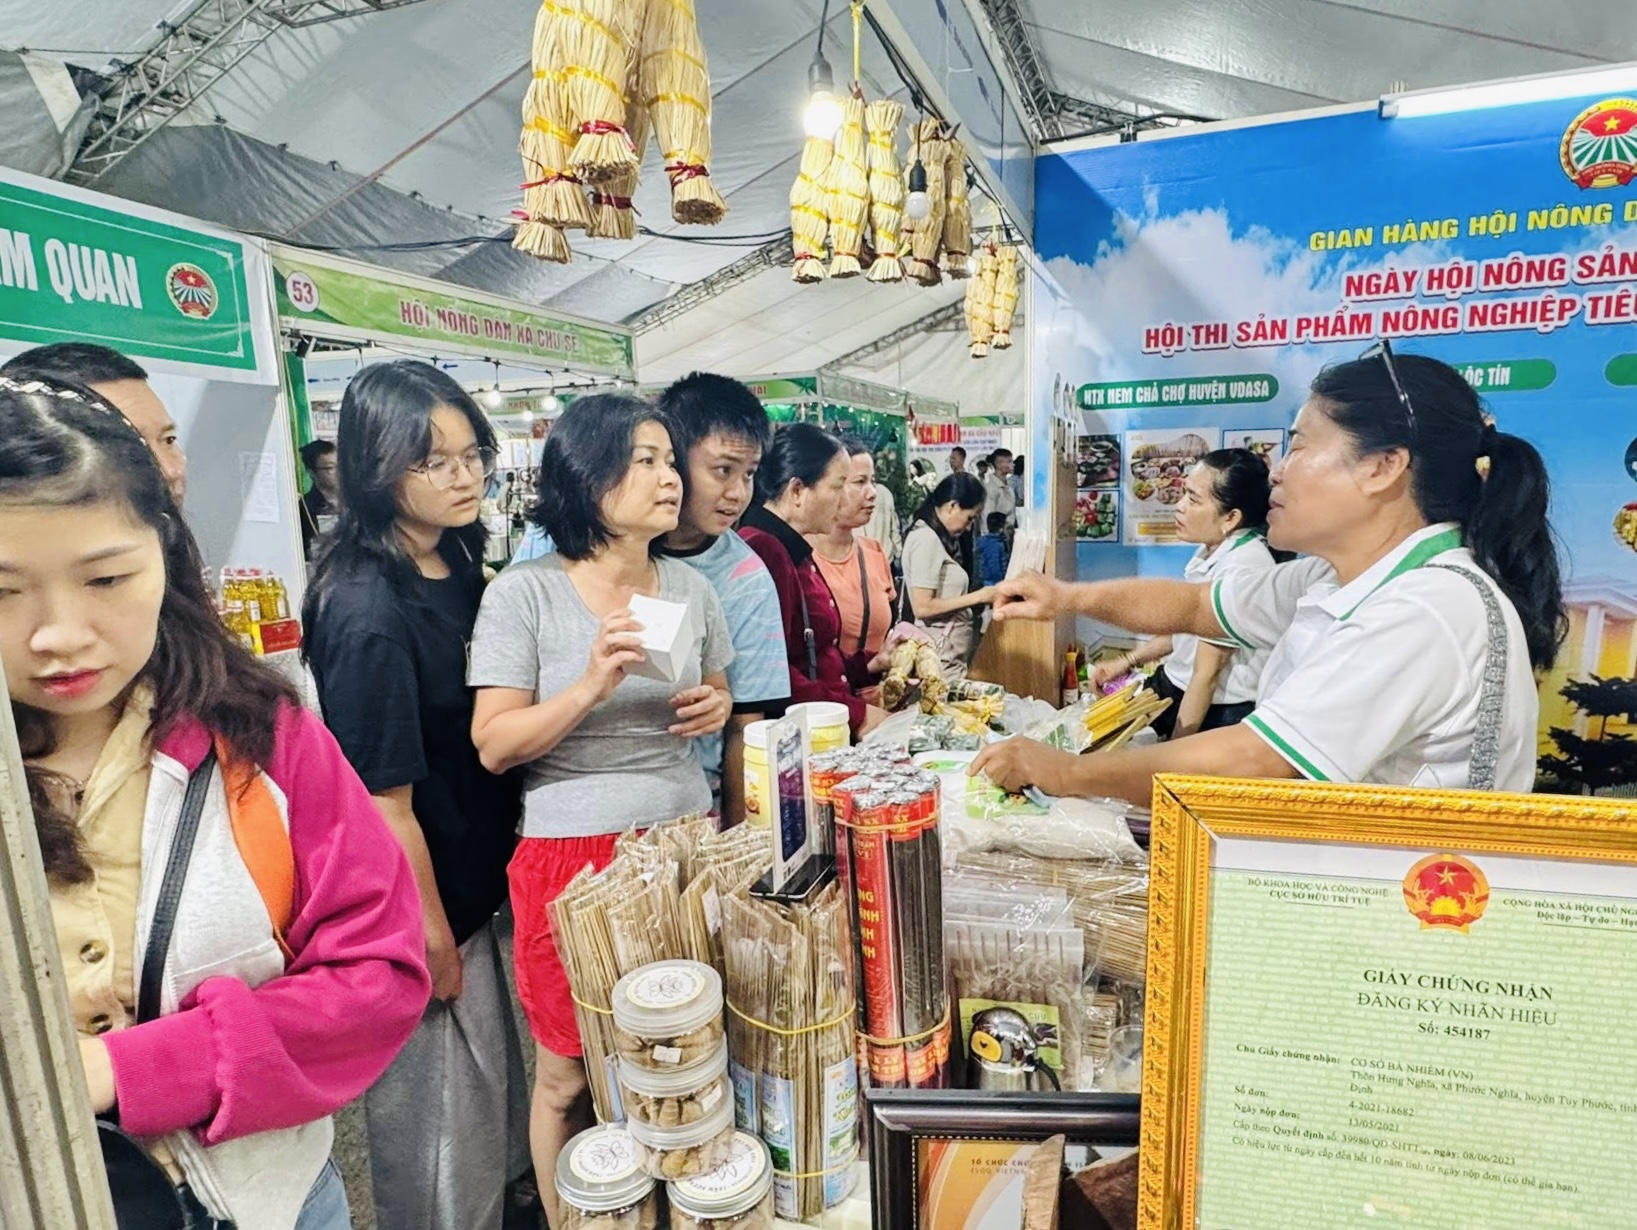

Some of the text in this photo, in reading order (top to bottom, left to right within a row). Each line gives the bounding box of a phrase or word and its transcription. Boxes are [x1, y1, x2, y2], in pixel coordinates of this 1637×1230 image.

[1309, 227, 1373, 251] GIAN
[1382, 218, 1459, 244] HÀNG
[1468, 209, 1517, 238] HỘI
[1527, 203, 1613, 231] NÔNG
[0, 227, 143, 310] M QUAN
[1344, 245, 1637, 297] NGÀY HỘI NÔNG SẢN
[292, 280, 314, 304] 53
[400, 299, 431, 331] HỘI
[1145, 289, 1637, 352] HỘI THI SẢN PHẨM NÔNG NGHIỆP TIÊ
[1488, 364, 1511, 386] TÍN
[1107, 387, 1133, 404] NEM
[1136, 382, 1158, 403] CHẢ
[1188, 380, 1226, 402] HUYỆN
[1248, 877, 1389, 897] BỘ KHOA HỌC VÀ CÔNG NGHỆ
[1269, 890, 1371, 906] CỤC SỞ HỮU TRÍ TUỆ
[1502, 898, 1532, 907] CỘNG
[1559, 901, 1573, 911] XÃ
[1574, 903, 1593, 913] HỘI
[1595, 904, 1618, 914] CHỦ
[1620, 907, 1637, 916] NG
[1536, 911, 1554, 920] Độc
[1556, 912, 1572, 922] lập
[1582, 914, 1596, 924] Tự
[1599, 916, 1610, 924] do
[1363, 967, 1553, 1002] GIẤY CHỨNG NHẬN
[1357, 991, 1557, 1026] ĐĂNG KÝ NHÃN HIỆU
[1418, 1020, 1491, 1040] Số: 454187
[1236, 1043, 1340, 1065] Chủ Giấy chứng nhận:
[1448, 1069, 1474, 1081] (VN)
[1234, 1084, 1269, 1098] Số đơn:
[1350, 1083, 1373, 1094] Định
[1350, 1070, 1375, 1081] Thôn
[1377, 1074, 1404, 1087] Hưng
[1407, 1077, 1438, 1091] Nghĩa,
[1441, 1083, 1453, 1091] xã
[1455, 1083, 1486, 1095] Phước
[1489, 1087, 1522, 1101] Nghĩa,
[1525, 1091, 1555, 1105] huyện
[1582, 1098, 1617, 1112] Phước,
[1233, 1102, 1300, 1119] Ngày nộp đơn:
[1348, 1100, 1415, 1117] 4-2021-18682
[1233, 1119, 1250, 1131] Cấp
[1252, 1122, 1271, 1132] theo
[1272, 1125, 1301, 1137] Quyết
[1303, 1130, 1324, 1140] định
[1348, 1118, 1400, 1133] 13/05/2021
[1232, 1136, 1245, 1145] Có
[1247, 1138, 1265, 1150] hiệu
[1267, 1141, 1281, 1151] lực
[1294, 1146, 1316, 1158] ngày
[1318, 1147, 1333, 1160] cấp
[1335, 1150, 1352, 1160] đến
[1354, 1151, 1368, 1163] hết
[1371, 1155, 1381, 1165] 10
[1383, 1157, 1403, 1168] năm
[1405, 1160, 1423, 1171] tính
[1438, 1165, 1461, 1177] ngày
[1462, 1169, 1480, 1180] nộp
[1482, 1171, 1501, 1182] đơn
[1503, 1173, 1519, 1185] (có
[1521, 1175, 1536, 1187] thể
[1538, 1180, 1554, 1190] gia
